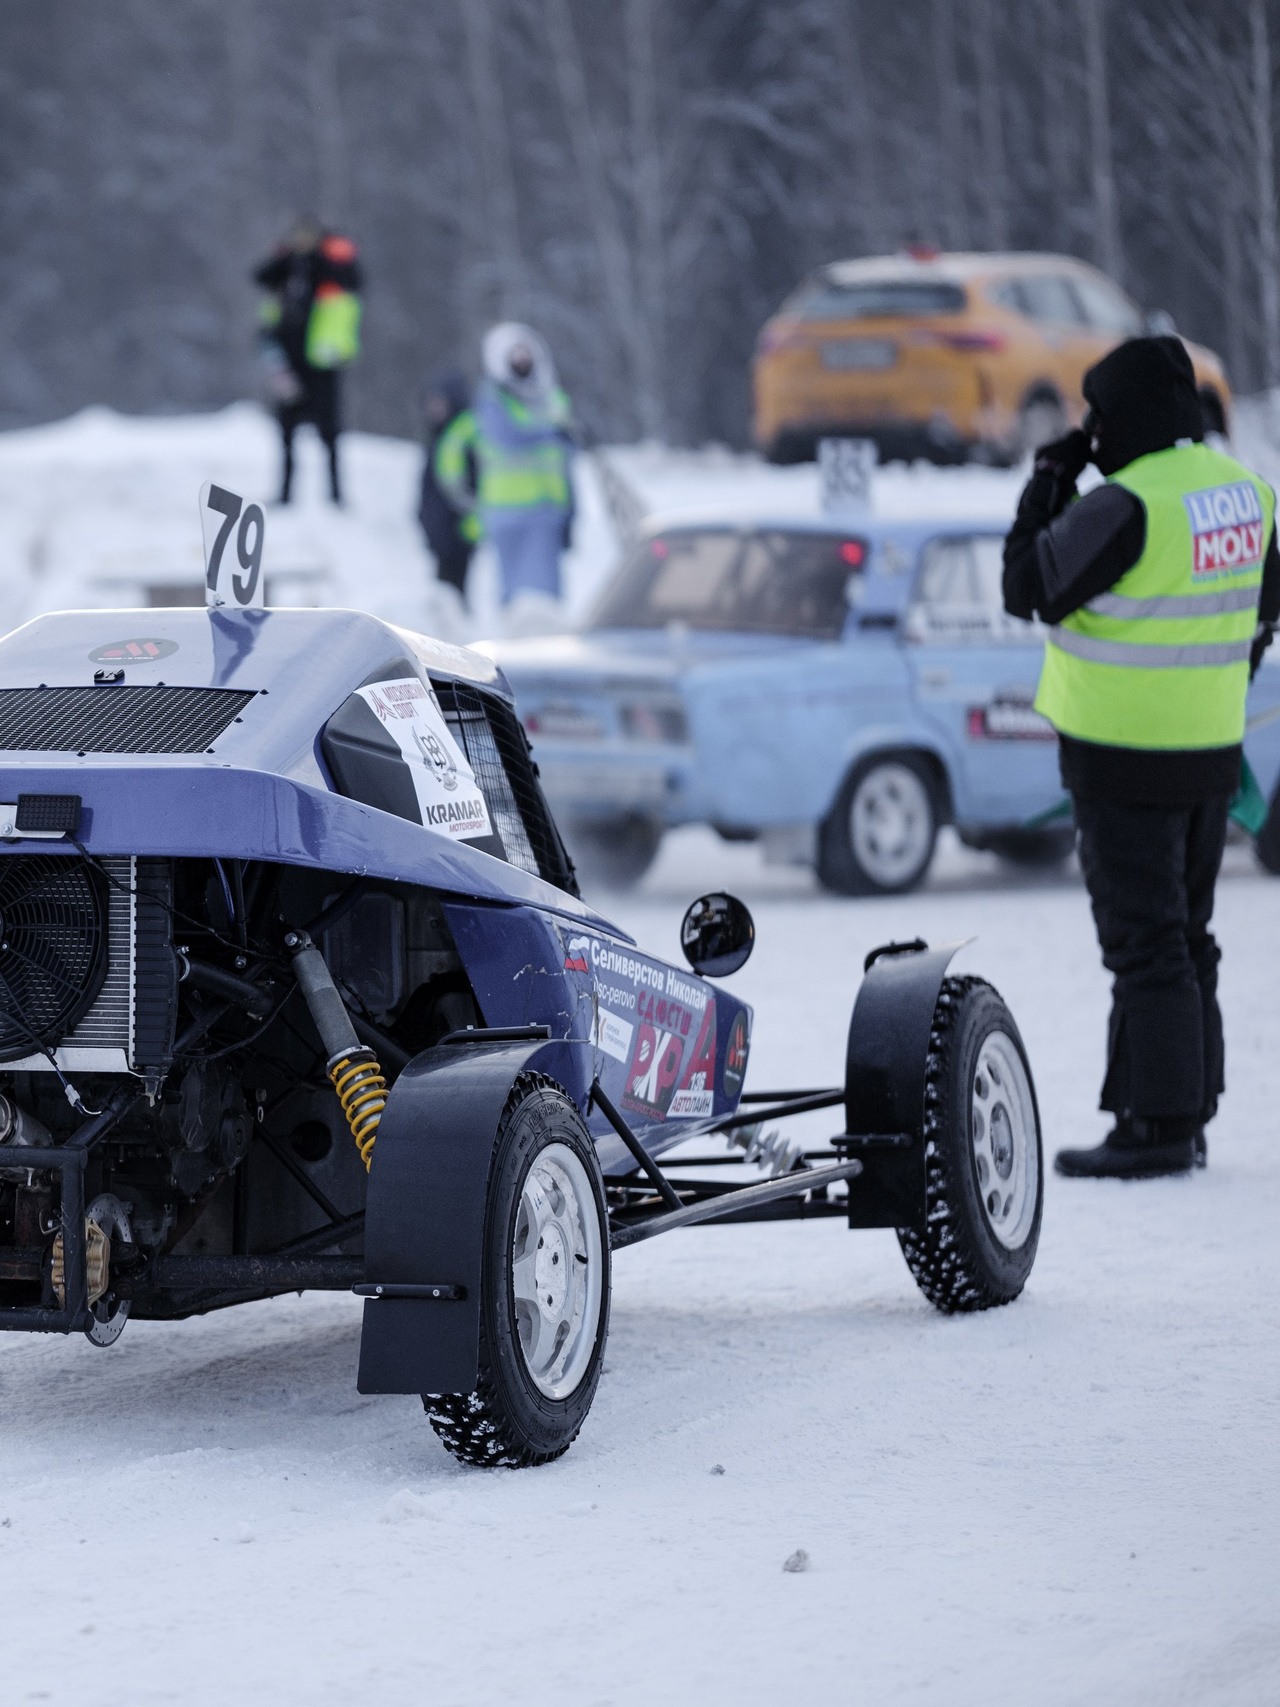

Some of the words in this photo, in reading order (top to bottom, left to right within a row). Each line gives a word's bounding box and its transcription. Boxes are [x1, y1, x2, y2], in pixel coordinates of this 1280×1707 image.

[1189, 485, 1259, 531] LIQUI
[207, 484, 265, 605] 79
[1198, 524, 1261, 567] MOLY
[426, 799, 484, 825] KRAMAR
[449, 820, 486, 833] MOTORSPORT
[591, 940, 665, 991] Селиверстов
[665, 969, 707, 1011] Николай
